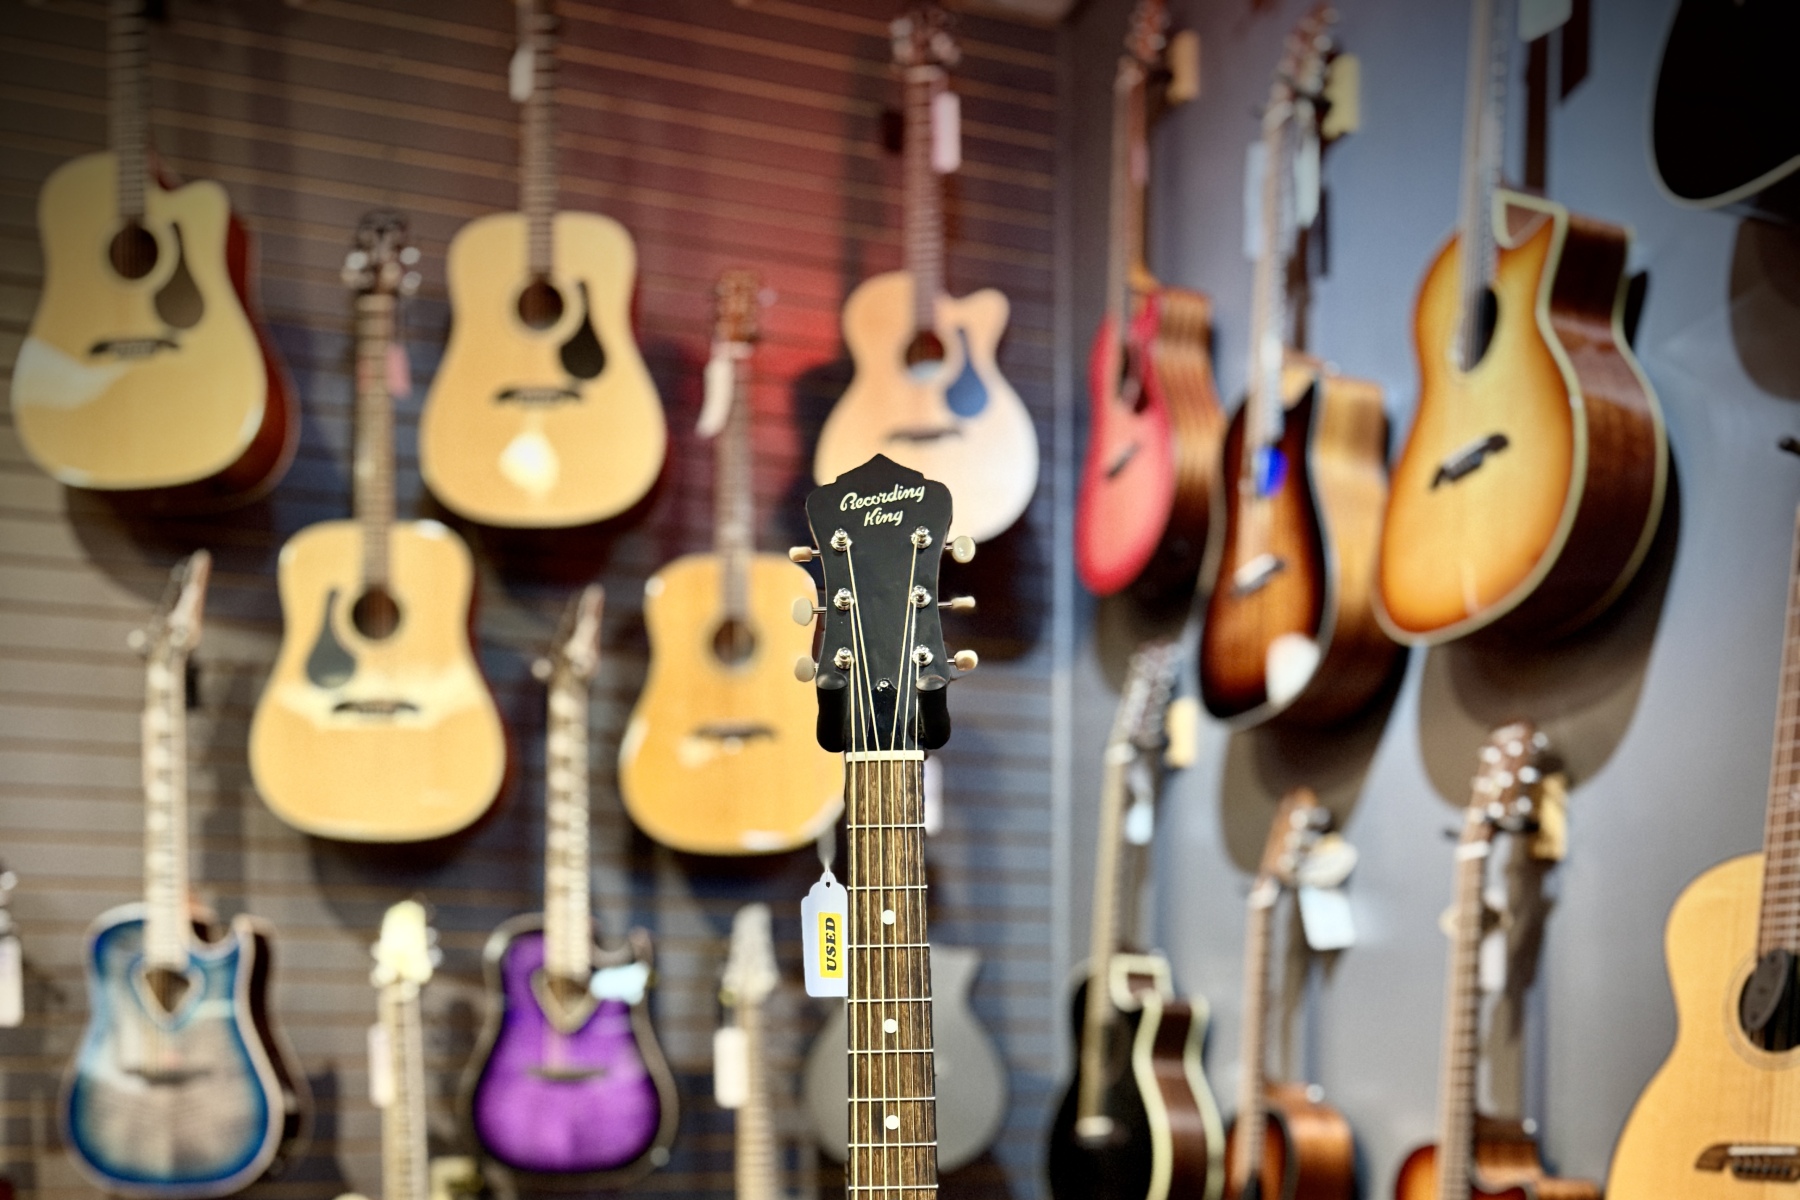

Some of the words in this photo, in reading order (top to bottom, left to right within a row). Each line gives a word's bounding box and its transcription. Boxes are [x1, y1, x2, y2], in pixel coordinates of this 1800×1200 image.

[839, 483, 926, 512] Recording
[863, 507, 904, 527] King
[825, 917, 837, 972] USED
